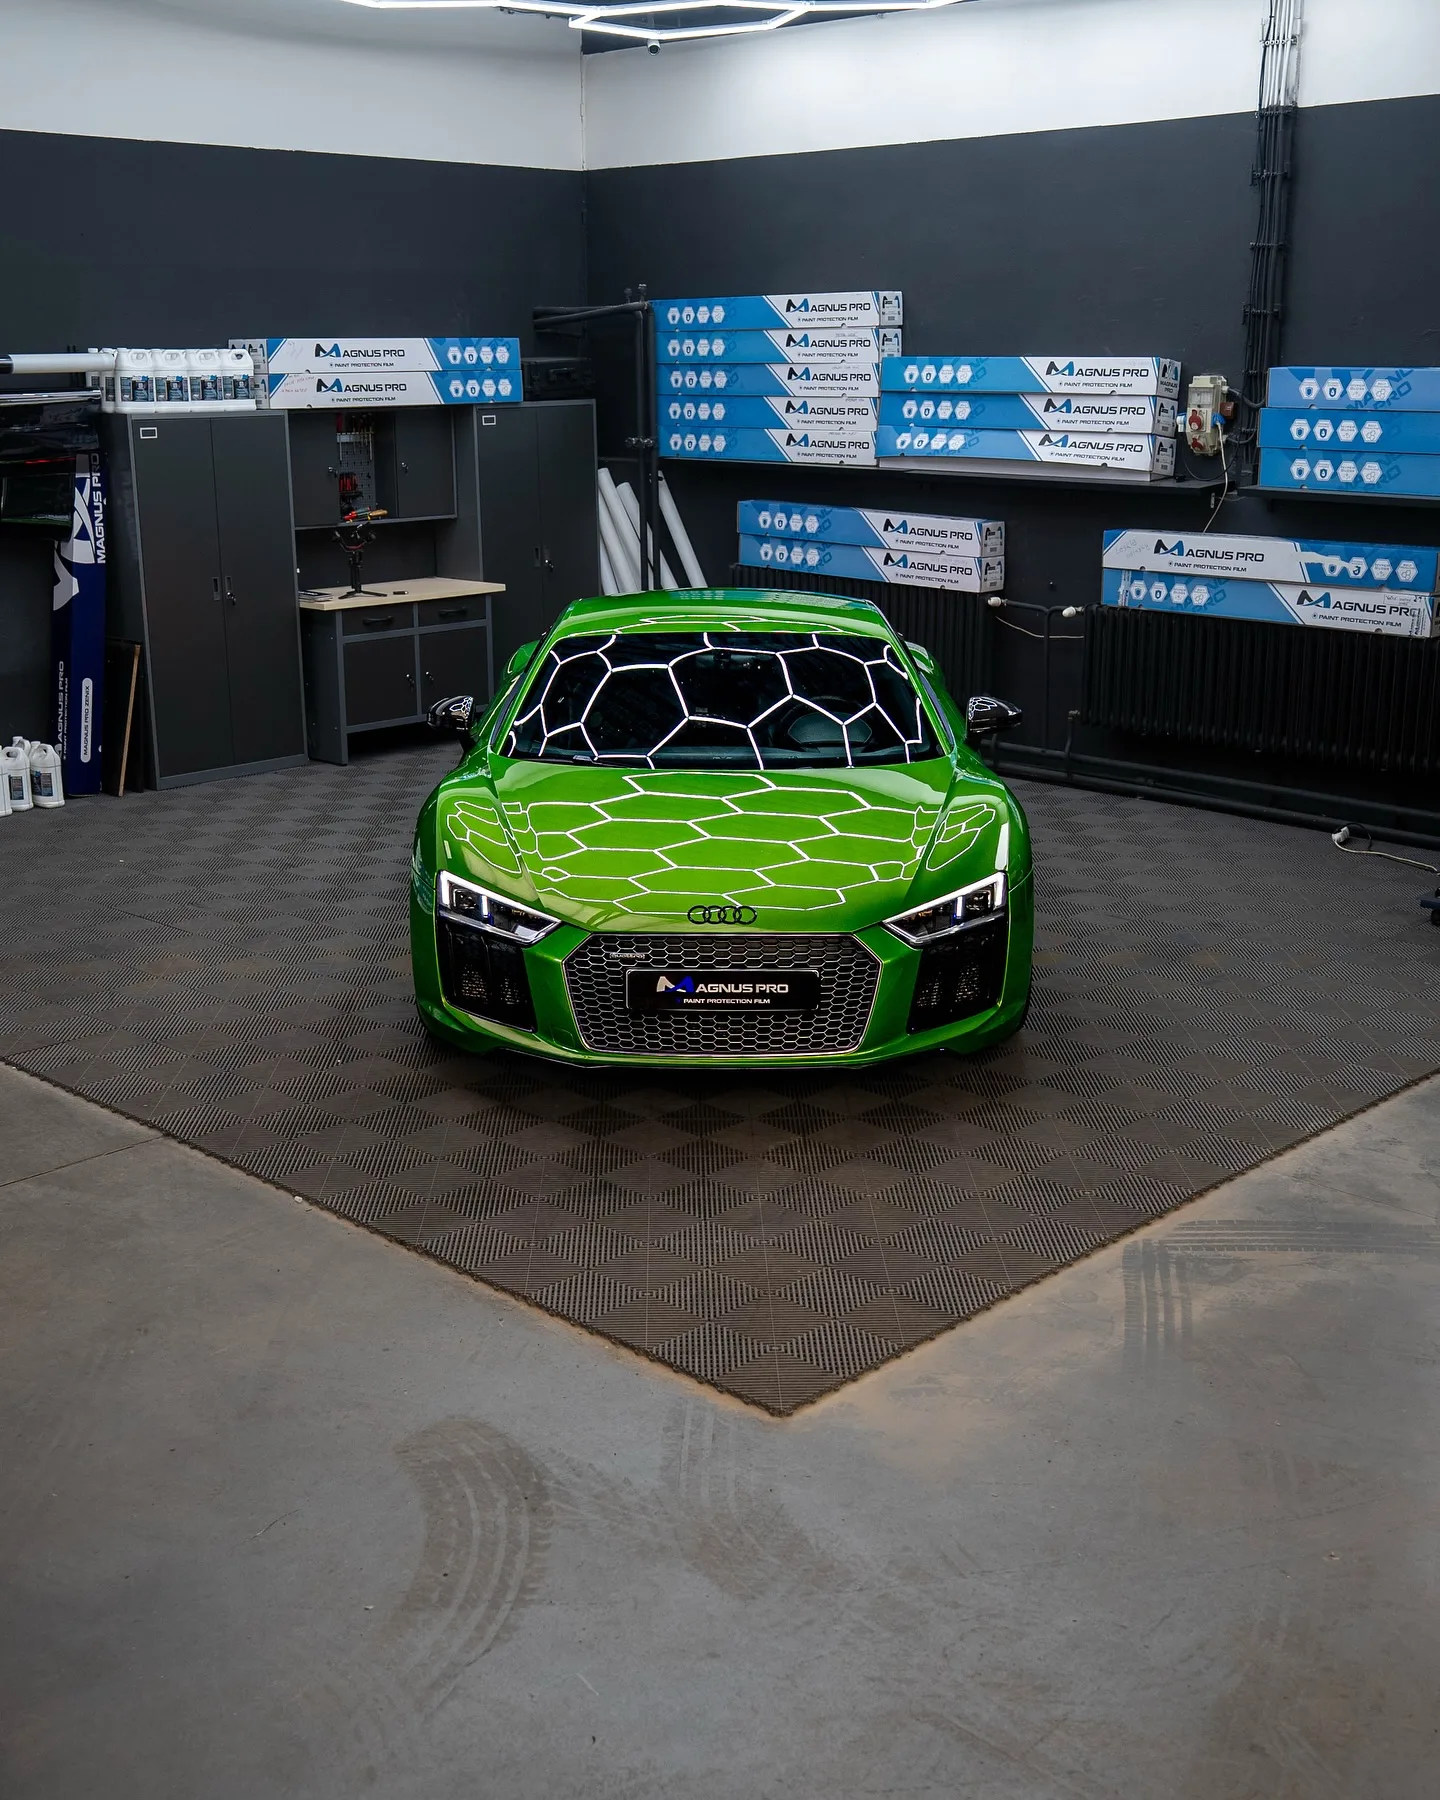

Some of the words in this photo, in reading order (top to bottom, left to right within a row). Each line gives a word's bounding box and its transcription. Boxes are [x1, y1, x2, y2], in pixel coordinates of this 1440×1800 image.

[785, 298, 847, 312] MAGNUS
[849, 303, 871, 311] PRO
[786, 333, 847, 348] MAGNUS
[849, 339, 871, 348] PRO
[314, 343, 382, 358] MAGNUS
[383, 349, 406, 357] PRO
[787, 366, 848, 381] MAGNUS
[850, 374, 871, 382] PRO
[1045, 361, 1120, 377] MAGNUS
[1122, 368, 1149, 378] PRO
[316, 378, 383, 393] MAGNUS
[385, 383, 407, 392] PRO
[785, 400, 846, 415] MAGNUS
[847, 407, 869, 416] PRO
[1043, 398, 1118, 414] MAGNUS
[1119, 406, 1146, 415] PRO
[785, 433, 847, 448] MAGNUS
[848, 441, 870, 449] PRO
[1038, 434, 1114, 451] MAGNUS
[1116, 443, 1144, 453] PRO
[1073, 453, 1110, 461] PROTECTION
[90, 453, 102, 488] PRO
[93, 490, 106, 564] MAGNUS
[883, 518, 948, 539] MAGNUS
[949, 531, 973, 540] PRO
[915, 540, 947, 548] PROTECTION
[1153, 539, 1234, 560] MAGNUS
[1235, 552, 1265, 562] PRO
[883, 552, 948, 573] MAGNUS
[949, 566, 973, 576] PRO
[1193, 563, 1231, 571] PROTECTION
[915, 575, 946, 583] PROTECTION
[1296, 589, 1387, 614] MAGNUS
[1340, 616, 1384, 626] PROTECTION
[656, 975, 753, 993] MAGNUS
[755, 984, 789, 993] PRO
